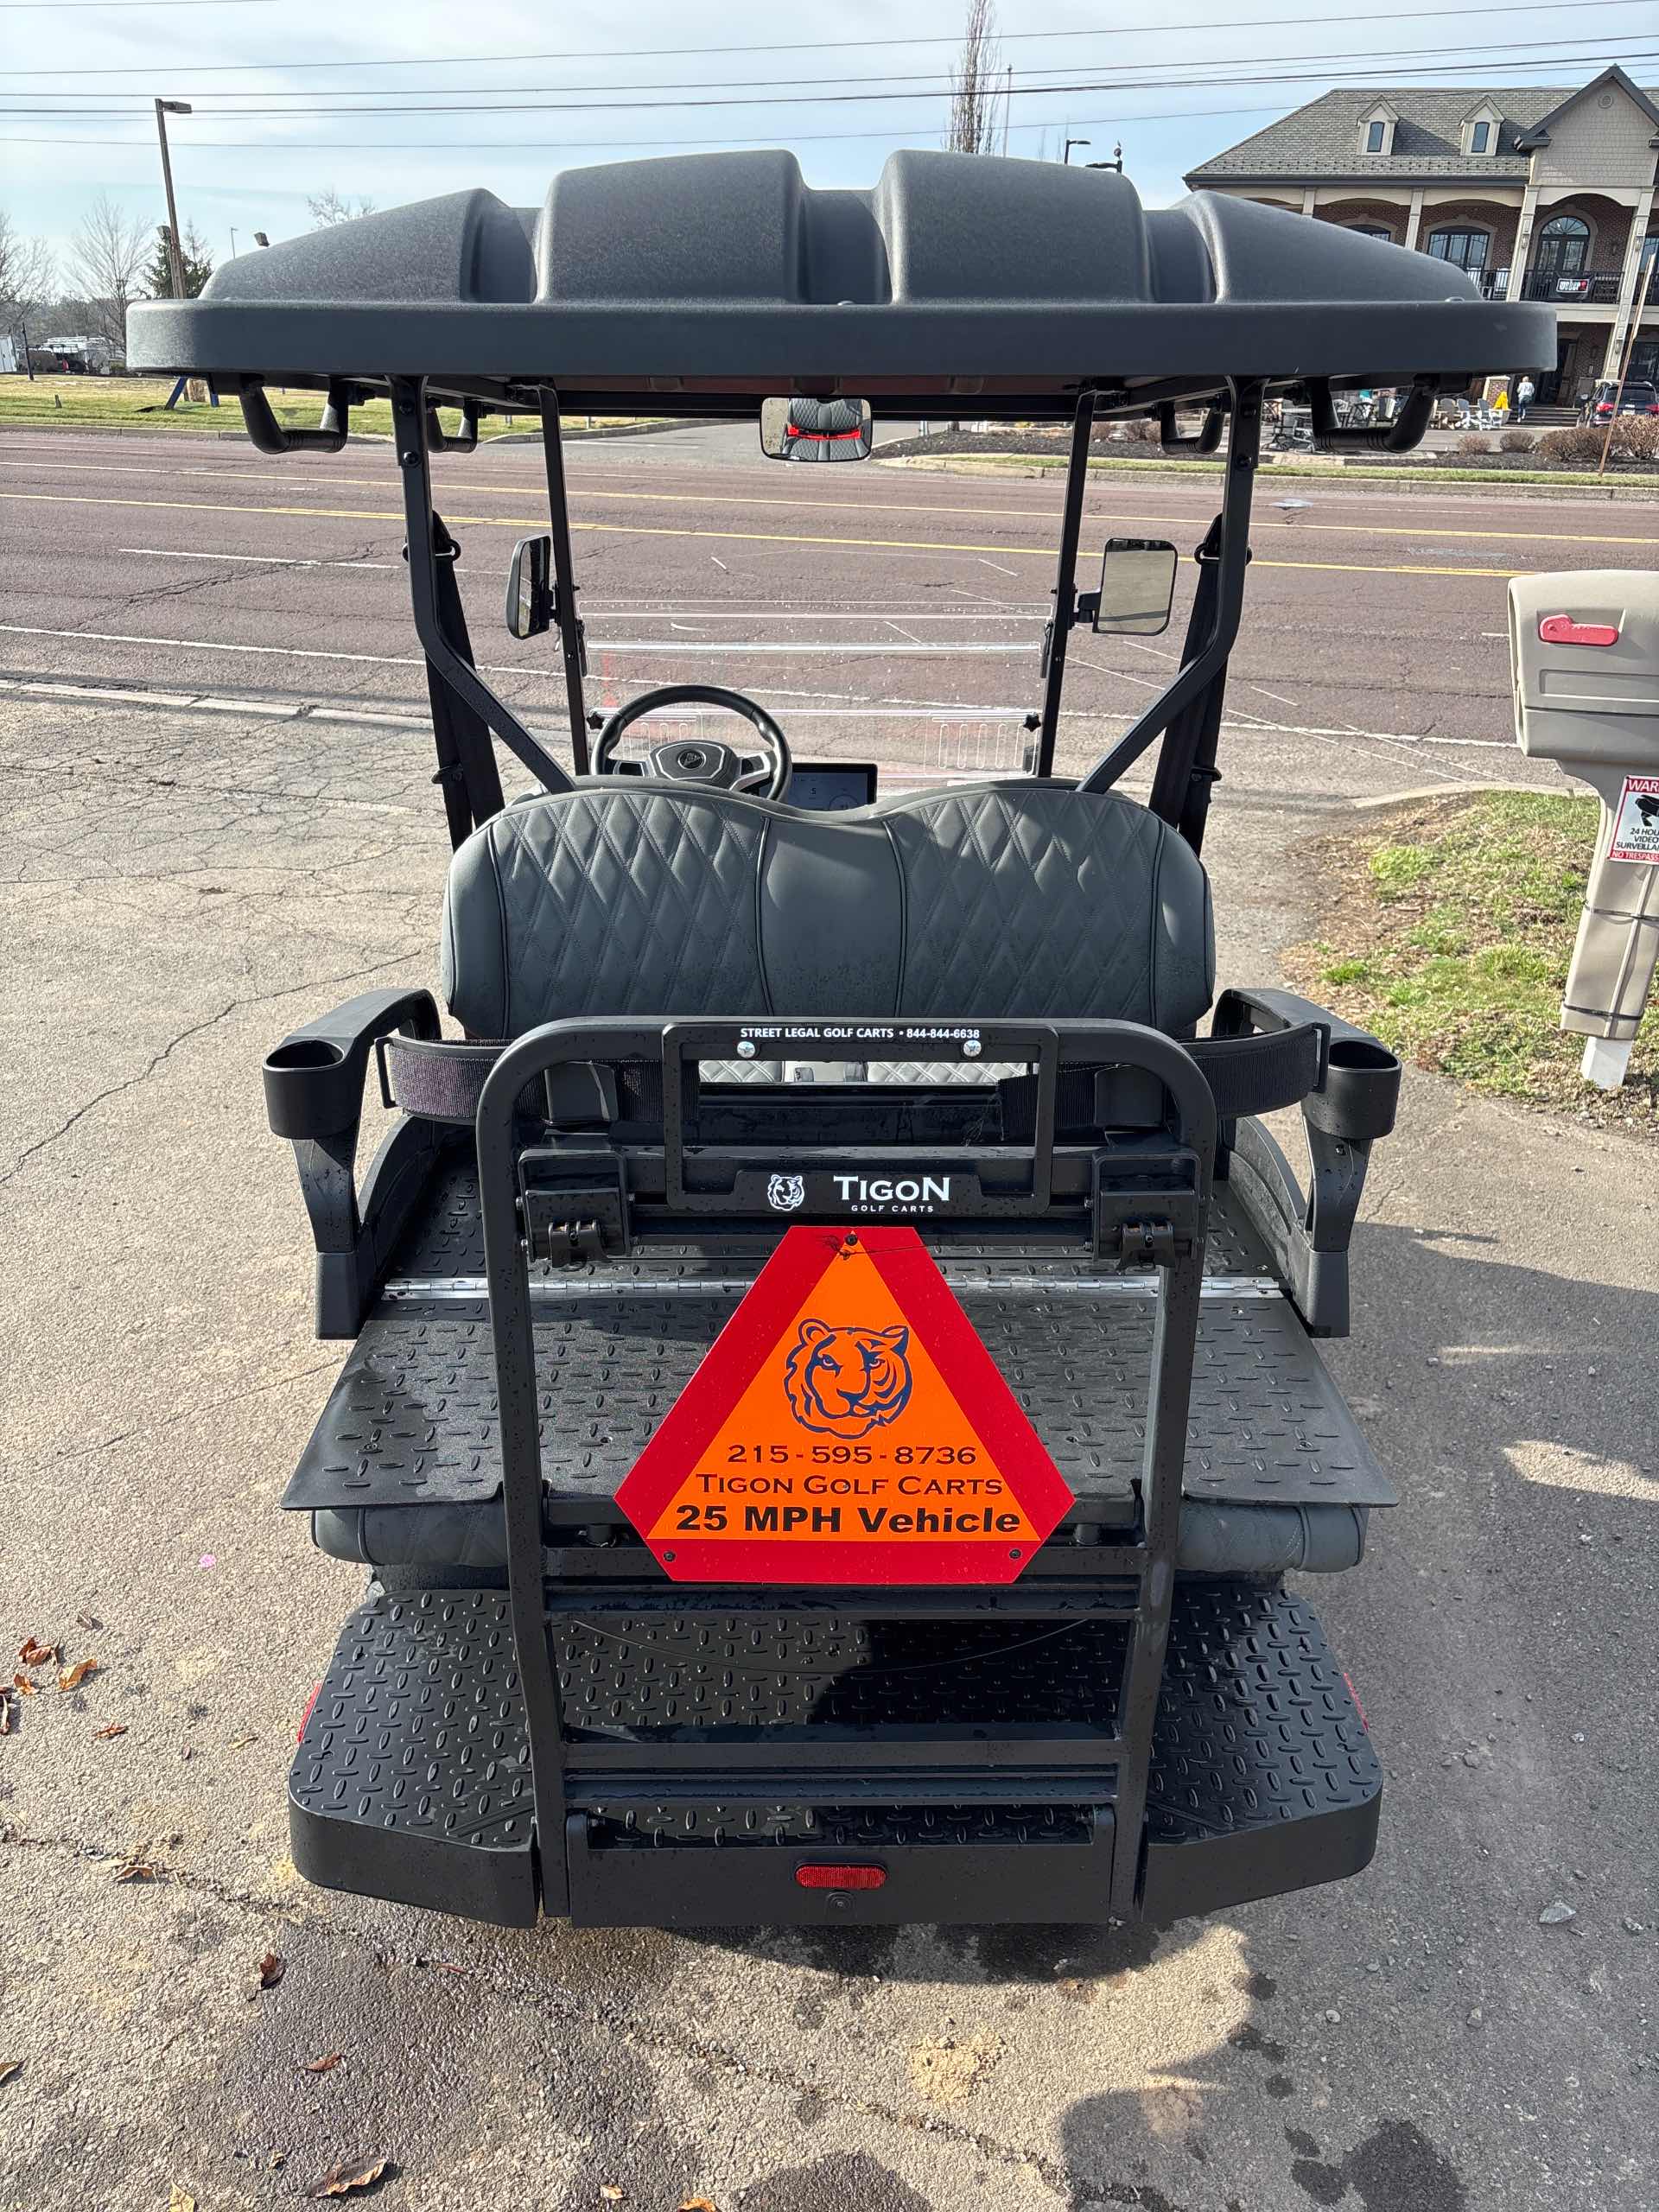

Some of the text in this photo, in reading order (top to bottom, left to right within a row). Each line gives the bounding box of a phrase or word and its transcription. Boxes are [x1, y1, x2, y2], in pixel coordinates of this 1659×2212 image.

[1628, 779, 1659, 792] WAR
[1630, 827, 1640, 836] 24
[1634, 836, 1659, 844] VIDEO
[1616, 841, 1659, 852] SURVEILLA
[1611, 850, 1624, 859] NO
[741, 1028, 980, 1039] STREET LEGAL GOLF CARTS 844-844-6638
[833, 1175, 951, 1201] TIGON
[696, 1473, 1003, 1496] TIGON GOLF CARTS
[676, 1505, 1021, 1534] 25 MPH Vehicle
